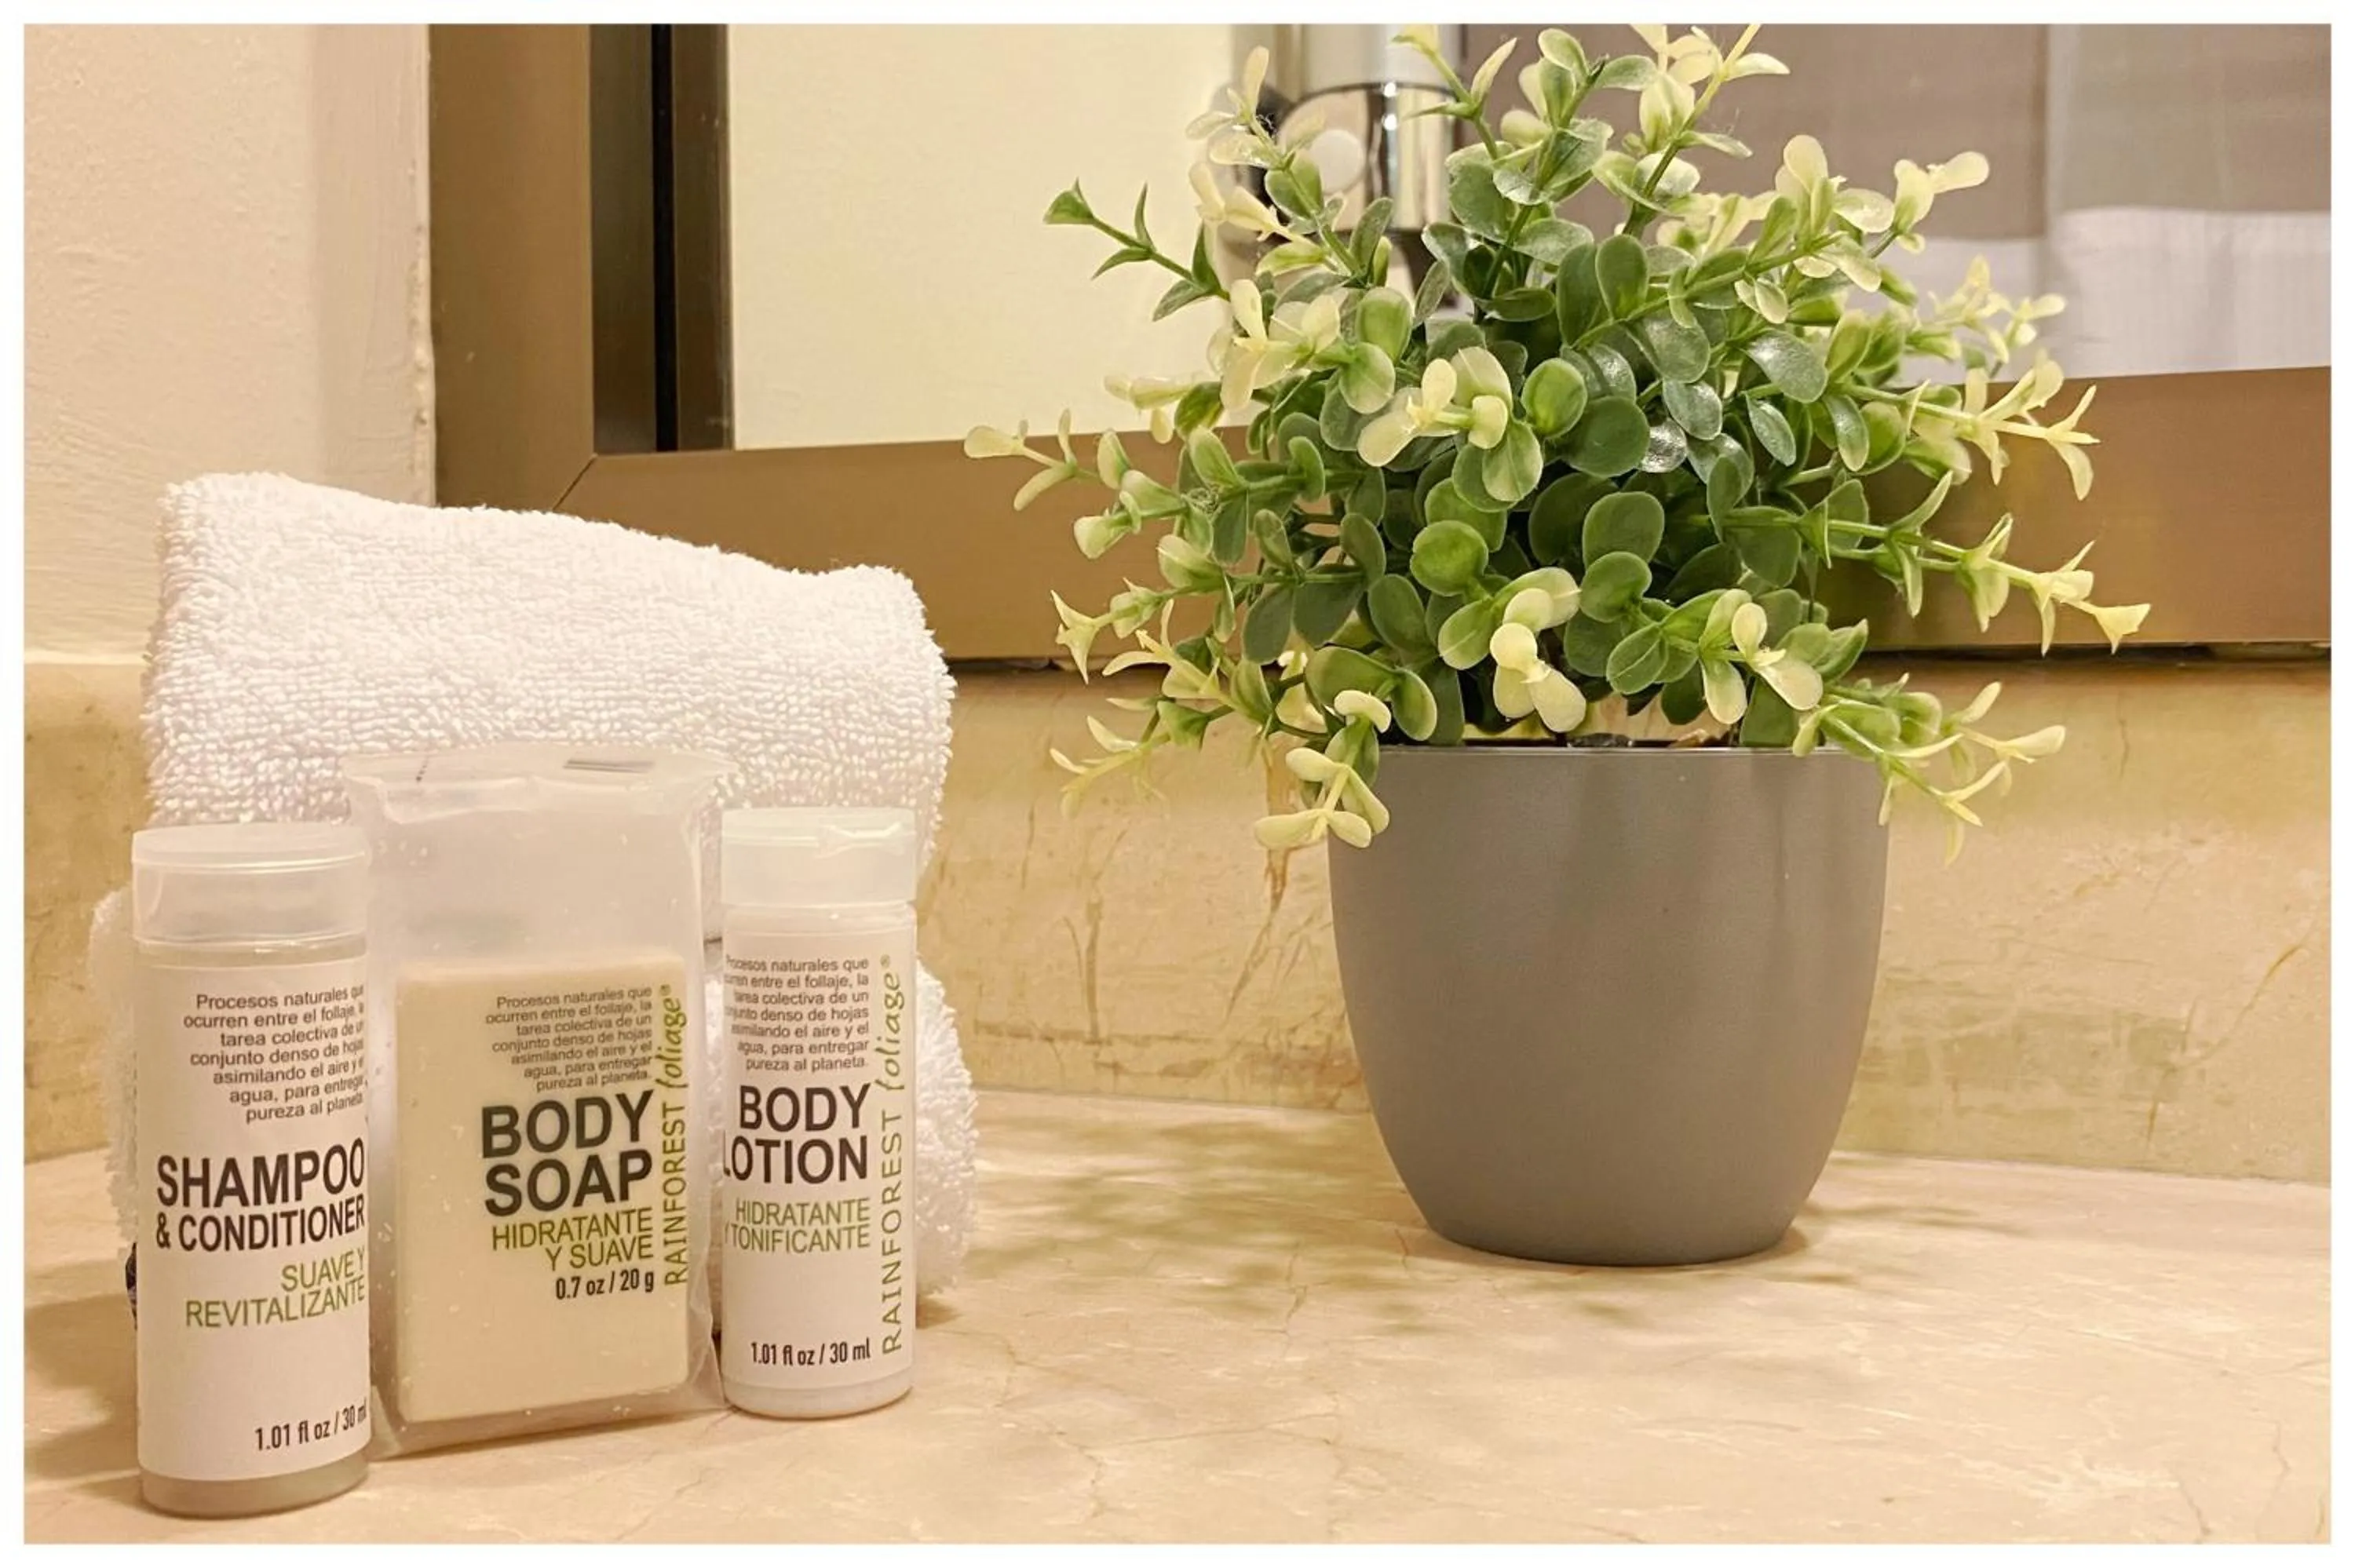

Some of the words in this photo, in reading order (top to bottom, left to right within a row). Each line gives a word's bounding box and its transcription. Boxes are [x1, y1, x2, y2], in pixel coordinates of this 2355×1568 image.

[772, 958, 838, 972] naturales
[843, 957, 869, 972] que
[751, 976, 783, 988] entre
[787, 974, 800, 988] el
[857, 972, 869, 986] la
[196, 994, 279, 1010] Procesos
[283, 986, 348, 1007] naturales
[497, 993, 560, 1009] Procesos
[564, 987, 624, 1005] naturales
[628, 986, 652, 998] que
[761, 990, 824, 1005] colectiva
[829, 990, 847, 1004] de
[852, 990, 869, 1002] un
[184, 1016, 248, 1028] ocurren
[254, 1012, 298, 1026] entre
[303, 1008, 316, 1023] el
[486, 1011, 538, 1025] ocurren
[542, 1008, 575, 1022] entre
[579, 1005, 591, 1017] el
[641, 1000, 652, 1012] la
[517, 1023, 551, 1036] tarea
[555, 1018, 612, 1034] colectiva
[615, 1013, 633, 1027] de
[636, 1014, 652, 1026] un
[761, 1008, 803, 1022] denso
[808, 1007, 827, 1021] de
[831, 1006, 869, 1023] hojas
[221, 1033, 266, 1047] tarea
[272, 1026, 338, 1045] colectiva
[341, 1024, 354, 1037] de
[492, 1037, 550, 1054] conjunto
[553, 1033, 593, 1048] denso
[597, 1030, 615, 1044] de
[618, 1027, 652, 1045] hojas
[795, 1024, 808, 1038] el
[813, 1023, 840, 1037] aire
[845, 1025, 854, 1039] y
[857, 1022, 869, 1034] el
[190, 1050, 265, 1069] conjunto
[269, 1047, 319, 1063] denso
[323, 1042, 339, 1058] de
[512, 1048, 582, 1065] asimilando
[586, 1045, 599, 1058] el
[602, 1041, 626, 1056] aire
[630, 1043, 638, 1056] y
[641, 1041, 652, 1052] el
[772, 1041, 804, 1056] para
[809, 1039, 870, 1056] entregar
[213, 1067, 306, 1085] asimilando
[311, 1063, 324, 1078] el
[327, 1059, 349, 1076] aire
[524, 1066, 559, 1080] agua,
[565, 1061, 595, 1076] para
[599, 1056, 652, 1074] entregar
[746, 1058, 789, 1071] pureza
[794, 1058, 806, 1070] al
[229, 1088, 278, 1107] agua,
[284, 1083, 319, 1103] para
[536, 1077, 582, 1092] pureza
[586, 1073, 598, 1086] al
[246, 1104, 305, 1124] pureza
[310, 1099, 323, 1115] al
[739, 1083, 871, 1132] BODY
[482, 1089, 654, 1159] BODY
[158, 1138, 365, 1208] SHAMPOO
[485, 1149, 652, 1217] SOAP
[662, 1102, 688, 1285] RAINFOREST
[157, 1213, 170, 1249] &
[179, 1194, 365, 1252] CONDITIONER
[736, 1196, 871, 1227] HIDRATANTE
[492, 1206, 653, 1251] HIDRATANTE
[731, 1223, 871, 1254] TONIFICANTE
[881, 1109, 902, 1355] RAINFOREST
[546, 1246, 562, 1271] Y
[569, 1234, 653, 1269] SUAVE
[282, 1250, 355, 1292] SUAVE
[357, 1244, 364, 1271] Y
[556, 1276, 581, 1300] 0.7
[586, 1278, 605, 1296] oz
[608, 1271, 615, 1293] /
[619, 1268, 640, 1290] 20
[644, 1271, 654, 1293] g
[185, 1274, 365, 1327] REVITALIZANTE
[750, 1342, 777, 1366] 1.01
[783, 1344, 794, 1366] fl
[798, 1349, 815, 1366] oz
[819, 1343, 825, 1365] /
[830, 1341, 848, 1364] 30
[853, 1336, 871, 1361] ml
[255, 1423, 290, 1450] 1.01
[298, 1419, 310, 1444] fl
[314, 1420, 330, 1440] oz
[334, 1410, 339, 1435] /
[342, 1404, 356, 1431] 30
